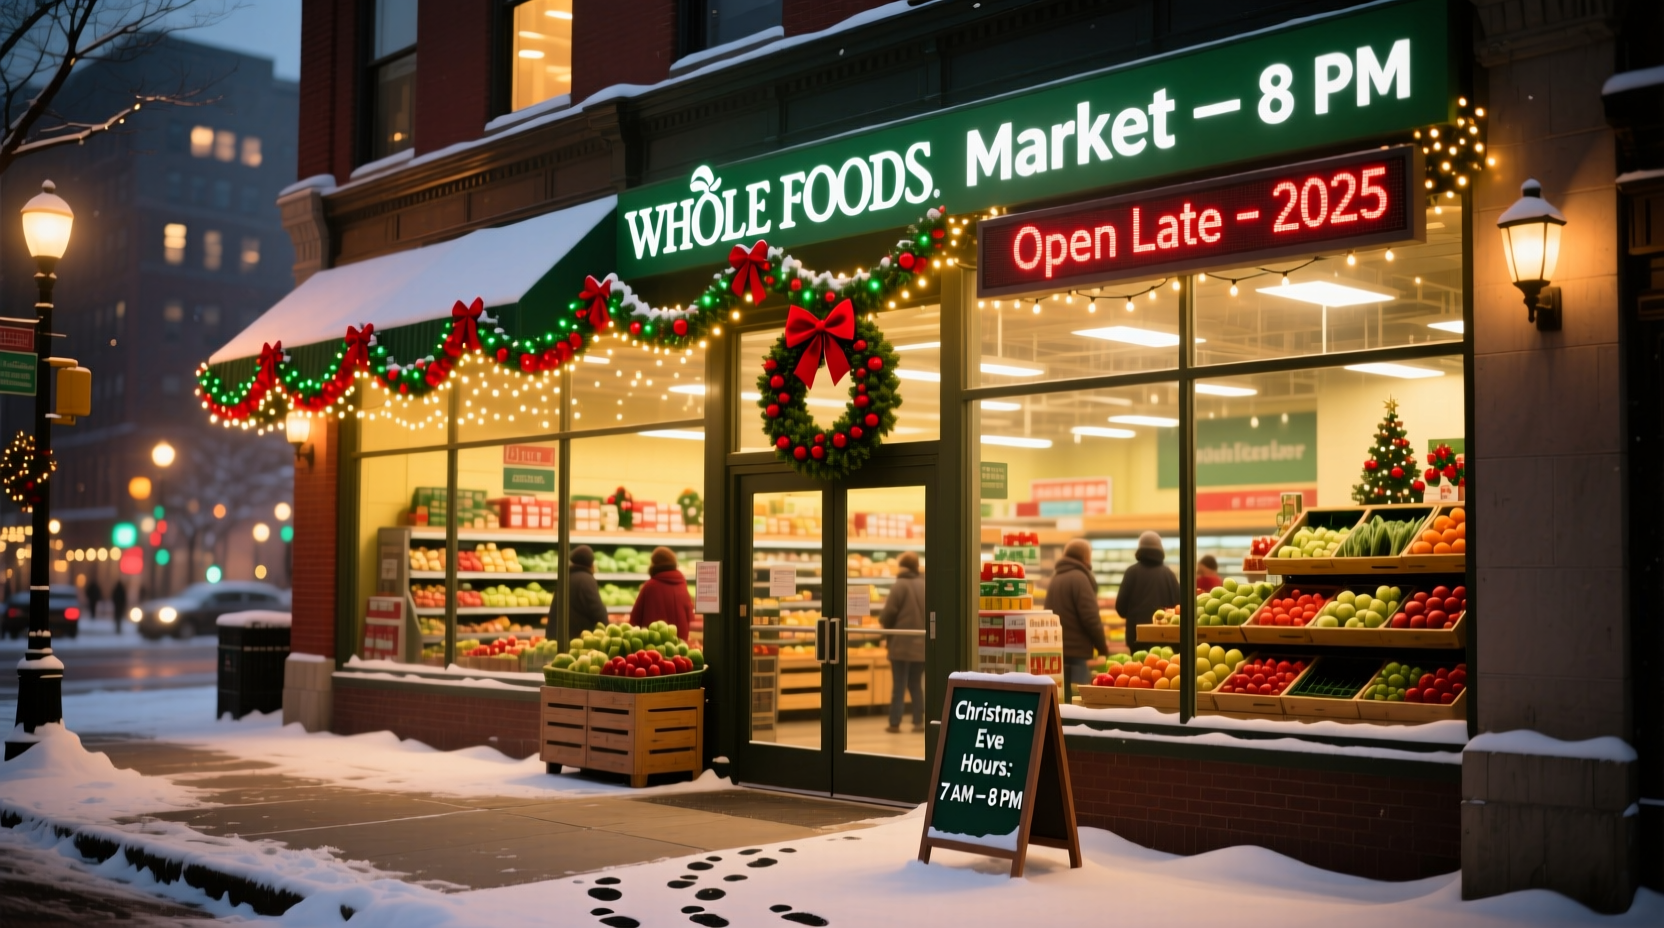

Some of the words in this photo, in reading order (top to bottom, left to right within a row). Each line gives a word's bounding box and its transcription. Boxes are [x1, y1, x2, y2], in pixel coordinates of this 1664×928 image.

[624, 177, 772, 260] WHOLE
[966, 87, 1176, 187] Market
[1257, 63, 1295, 125] 8
[1314, 38, 1411, 115] PM
[1012, 224, 1118, 278] Open
[1131, 202, 1223, 255] Late
[1272, 166, 1388, 233] 2025
[955, 700, 1034, 726] Christmas
[974, 728, 1005, 750] Eve
[960, 753, 1013, 778] Hours:
[987, 787, 998, 807] 8
[999, 788, 1024, 810] PM
